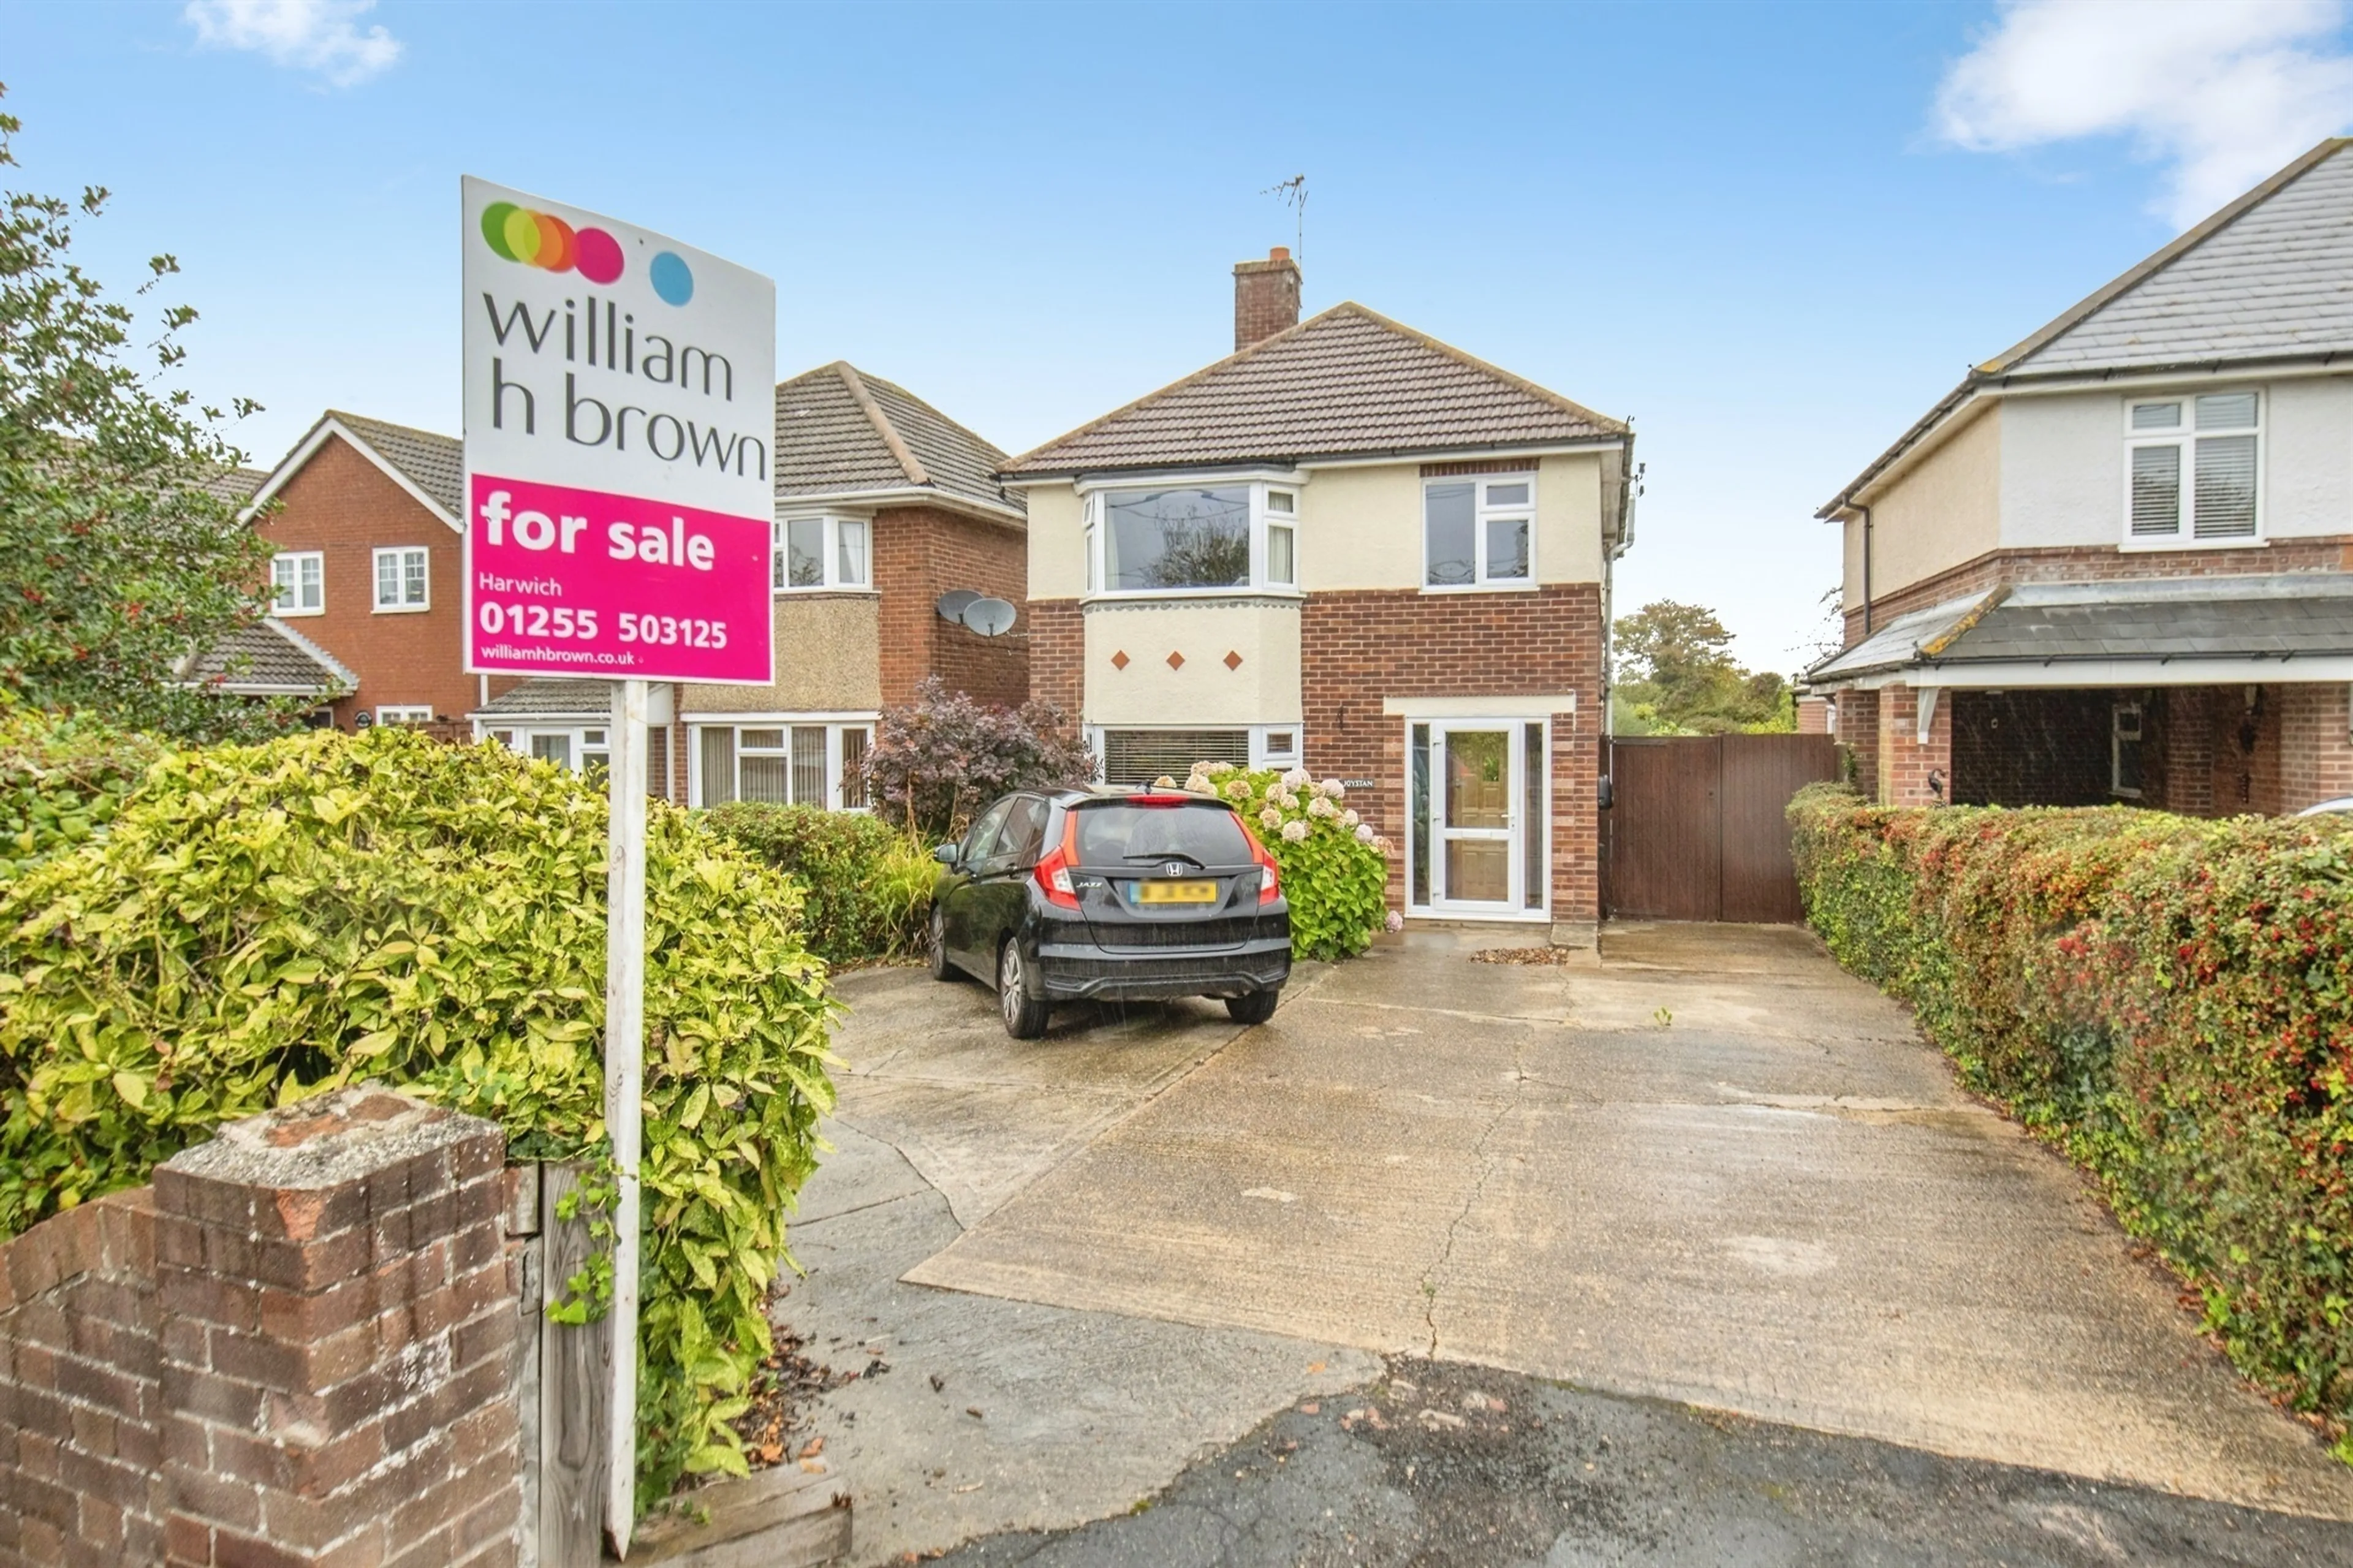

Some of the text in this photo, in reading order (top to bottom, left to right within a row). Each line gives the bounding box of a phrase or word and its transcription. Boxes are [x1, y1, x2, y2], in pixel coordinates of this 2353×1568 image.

[483, 292, 732, 401] william
[493, 357, 765, 480] h brown
[480, 490, 714, 570] for sale
[479, 572, 562, 597] Harwich
[480, 602, 727, 649] 01255 503125
[481, 645, 635, 665] williamhbrown.co.uk
